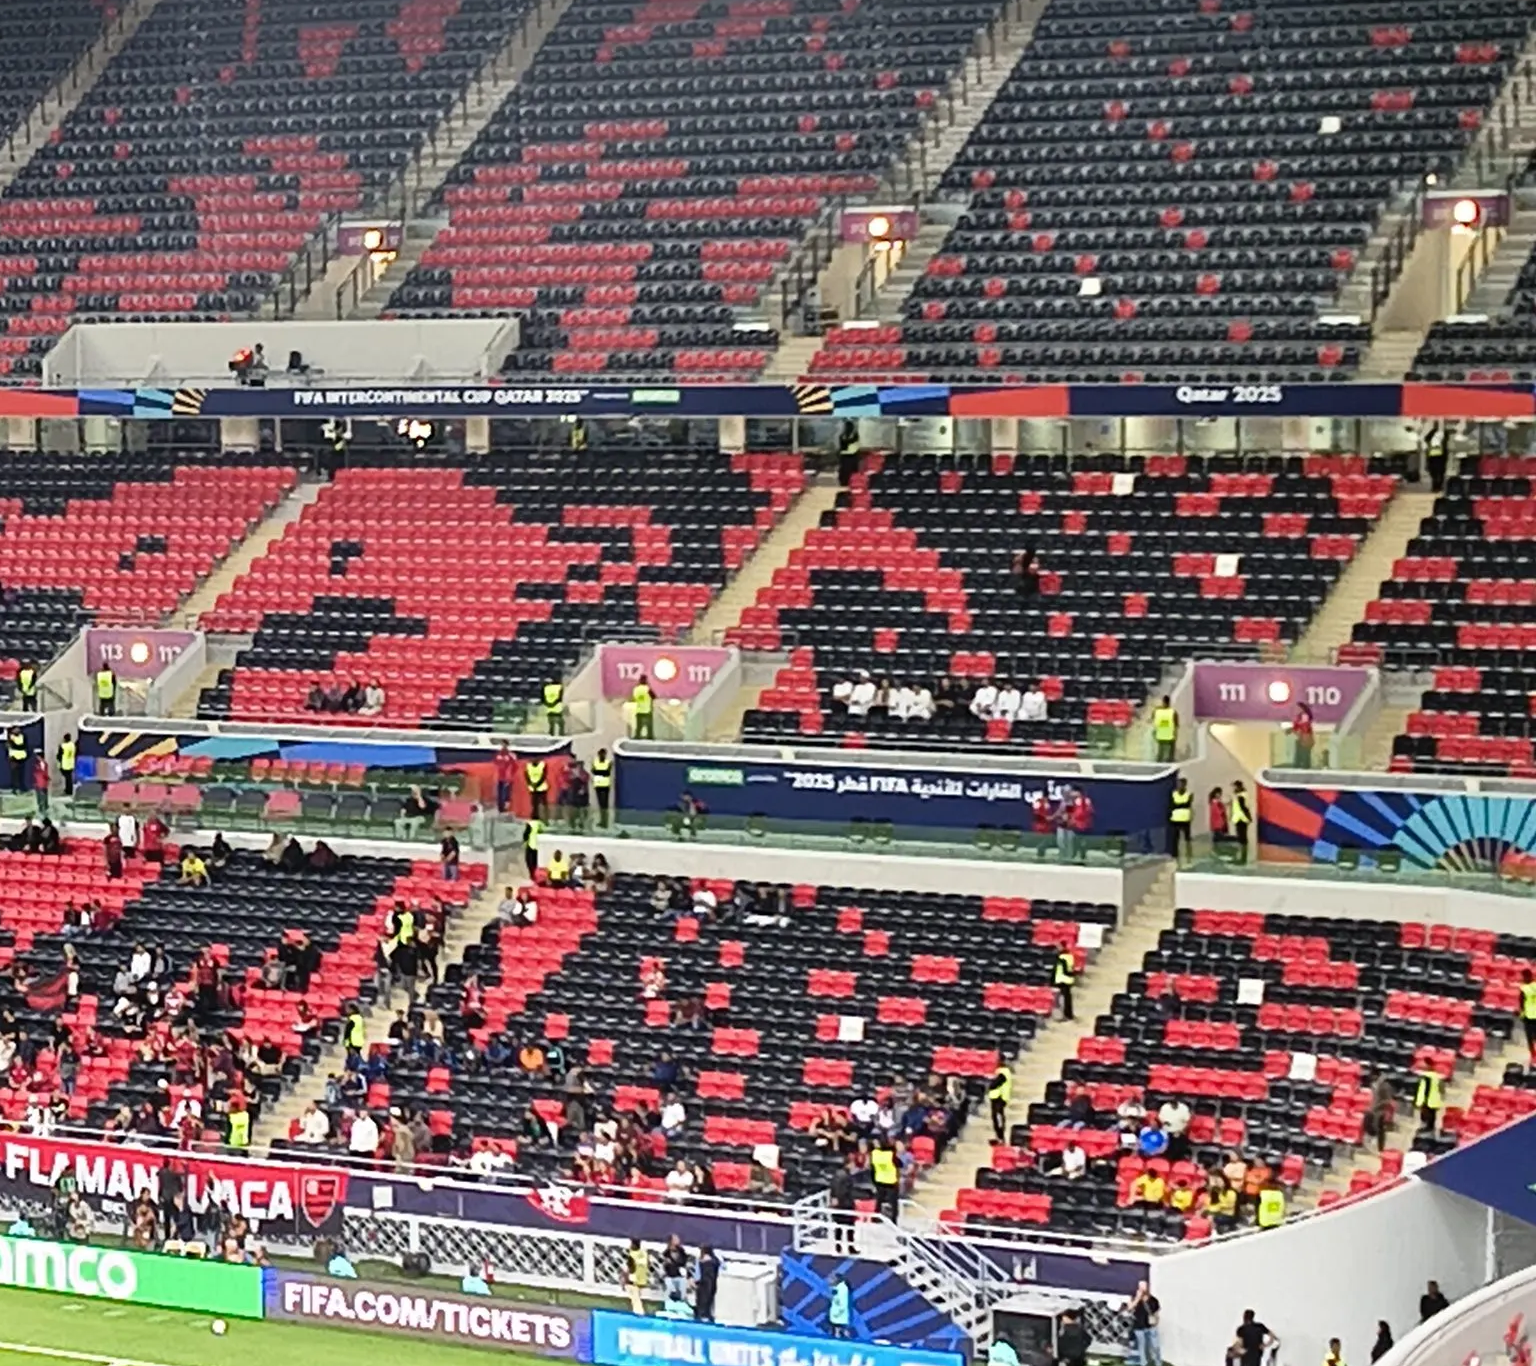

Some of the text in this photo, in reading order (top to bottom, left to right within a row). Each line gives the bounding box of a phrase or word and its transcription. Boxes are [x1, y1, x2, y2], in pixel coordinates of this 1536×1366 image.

[1175, 385, 1282, 404] Qatar 2025
[99, 643, 124, 661] 113
[687, 664, 711, 683] 111
[1218, 682, 1246, 703] 111
[1305, 685, 1342, 706] 110
[869, 776, 909, 794] FIFA
[283, 1279, 571, 1349] FIFA.COM/TICKETS
